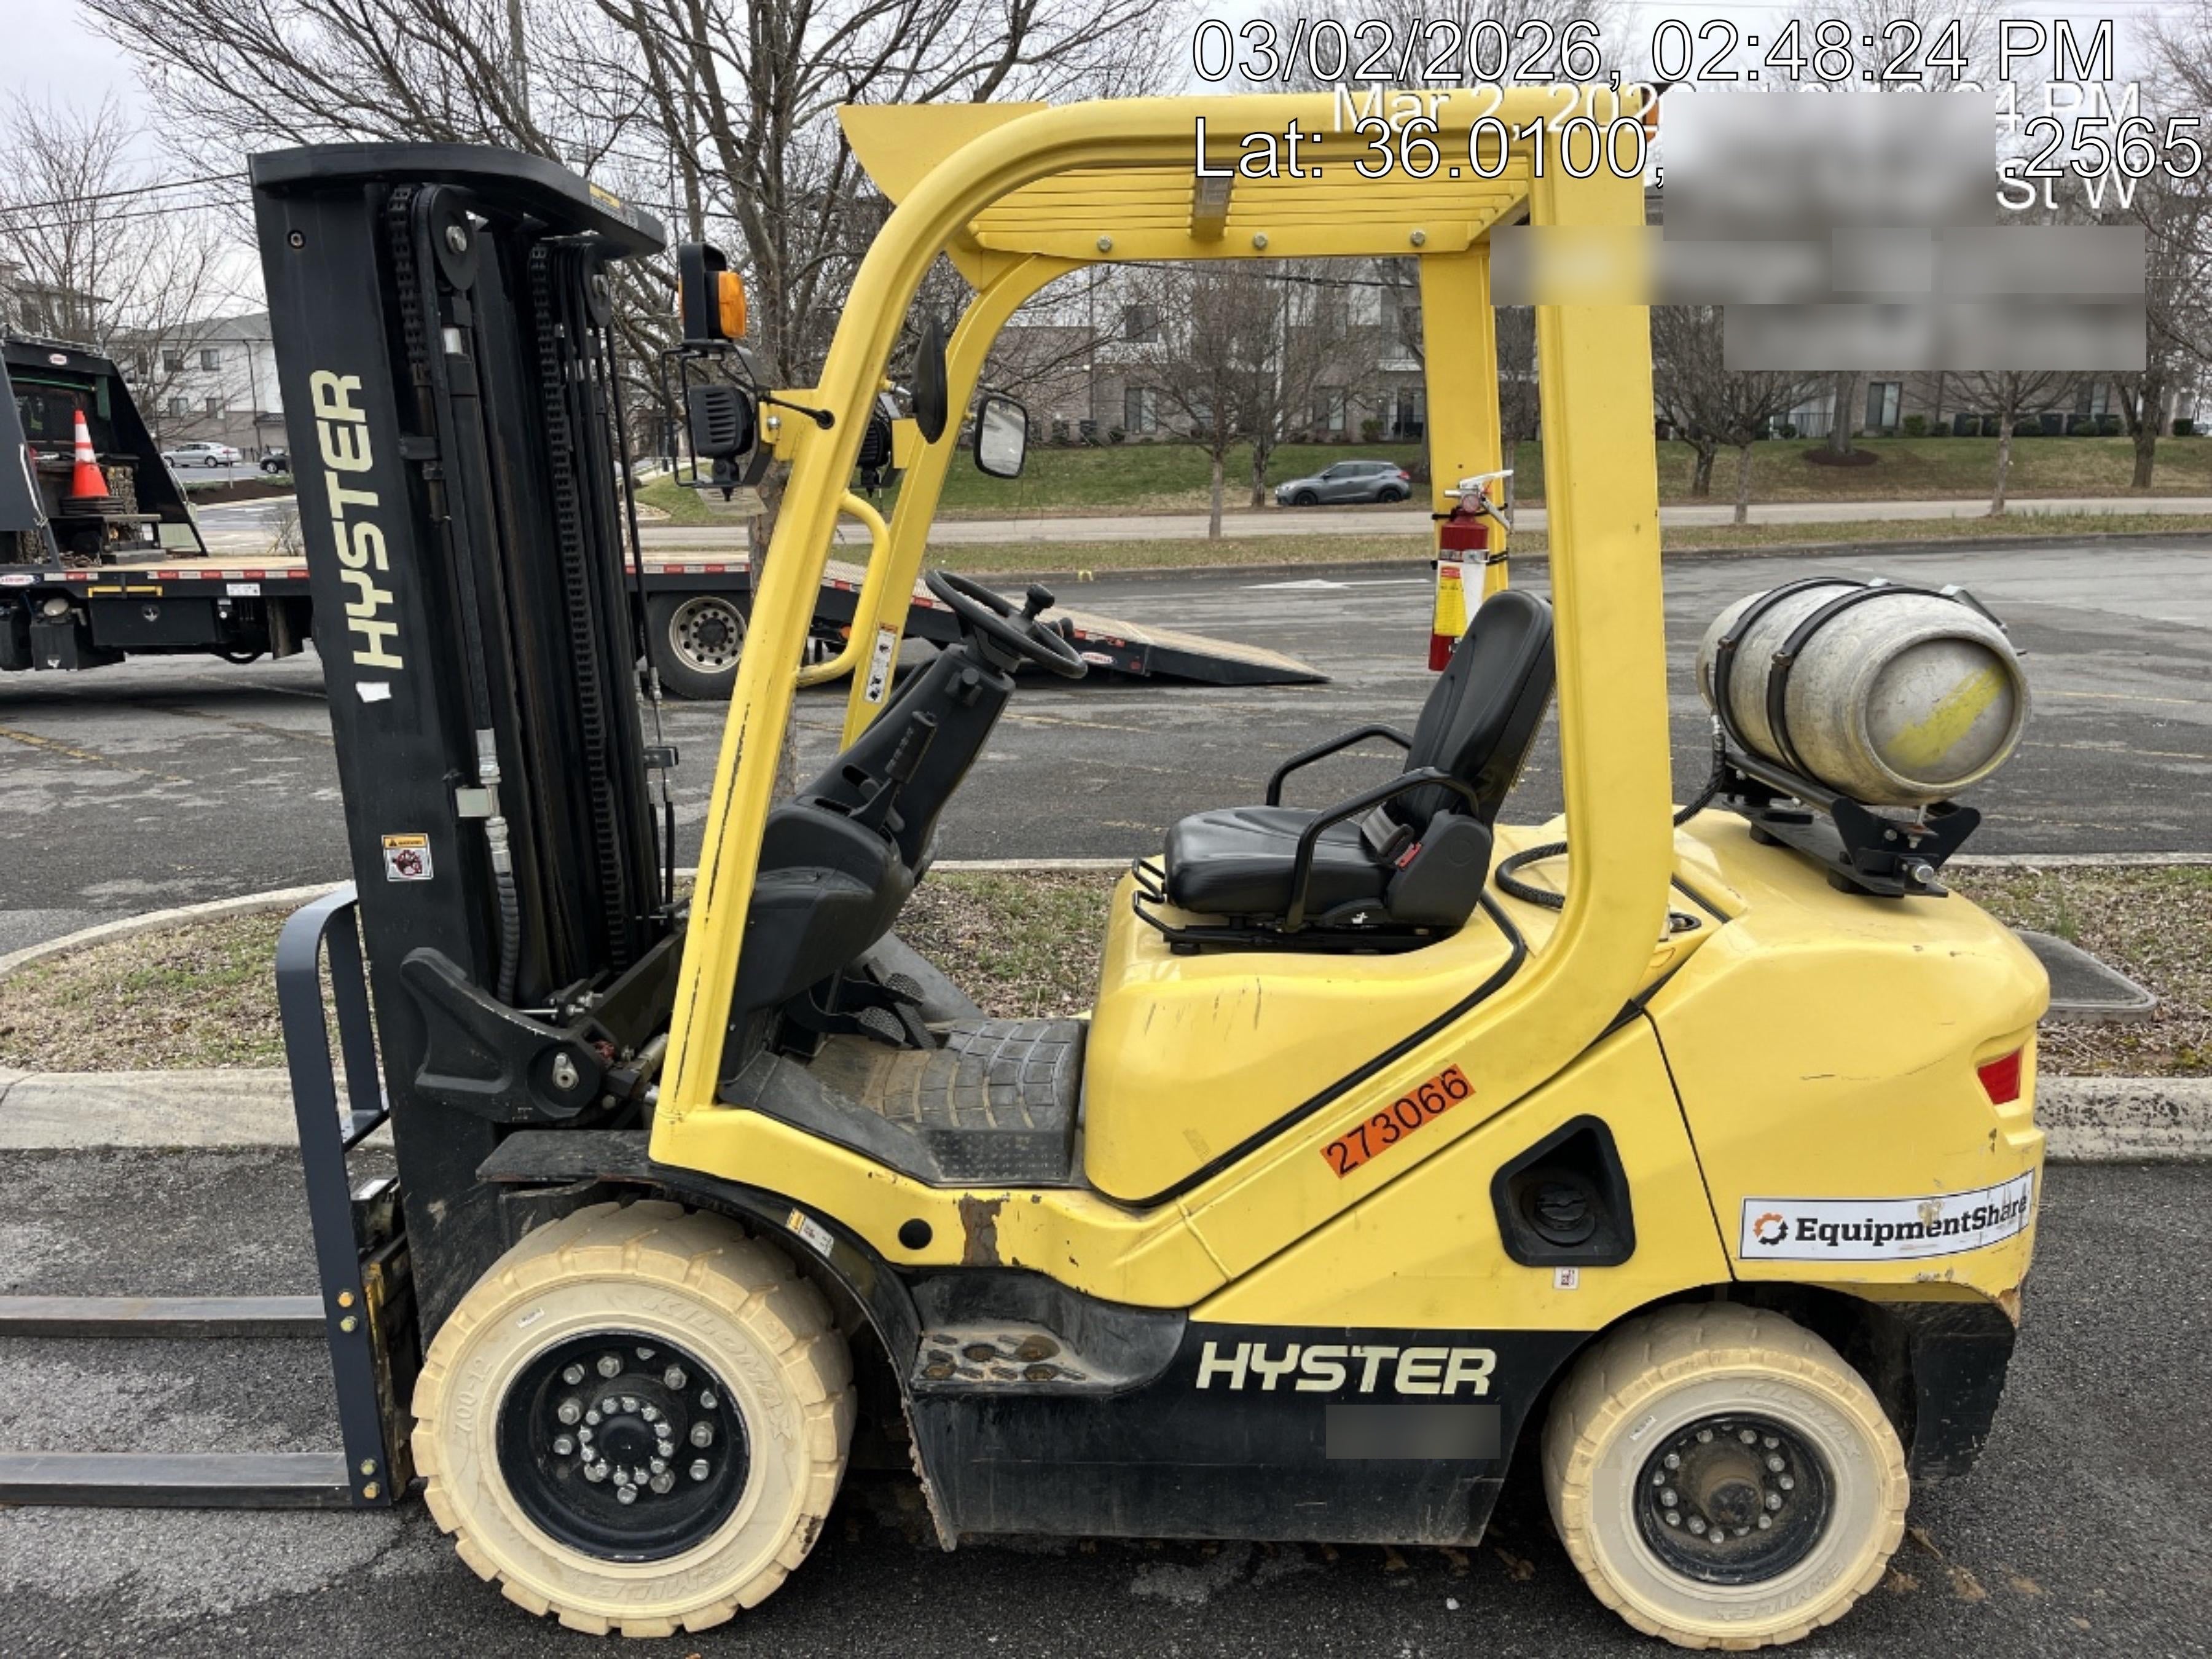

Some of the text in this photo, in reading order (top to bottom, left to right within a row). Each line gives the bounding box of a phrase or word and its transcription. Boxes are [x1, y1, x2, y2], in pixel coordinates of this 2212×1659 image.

[309, 370, 404, 670] HYSTER
[1326, 1068, 1469, 1175] 273066
[1795, 1196, 2027, 1247] EquipmentShare
[641, 1294, 794, 1441] KILOMAX
[1196, 1341, 1498, 1397] HYSTER
